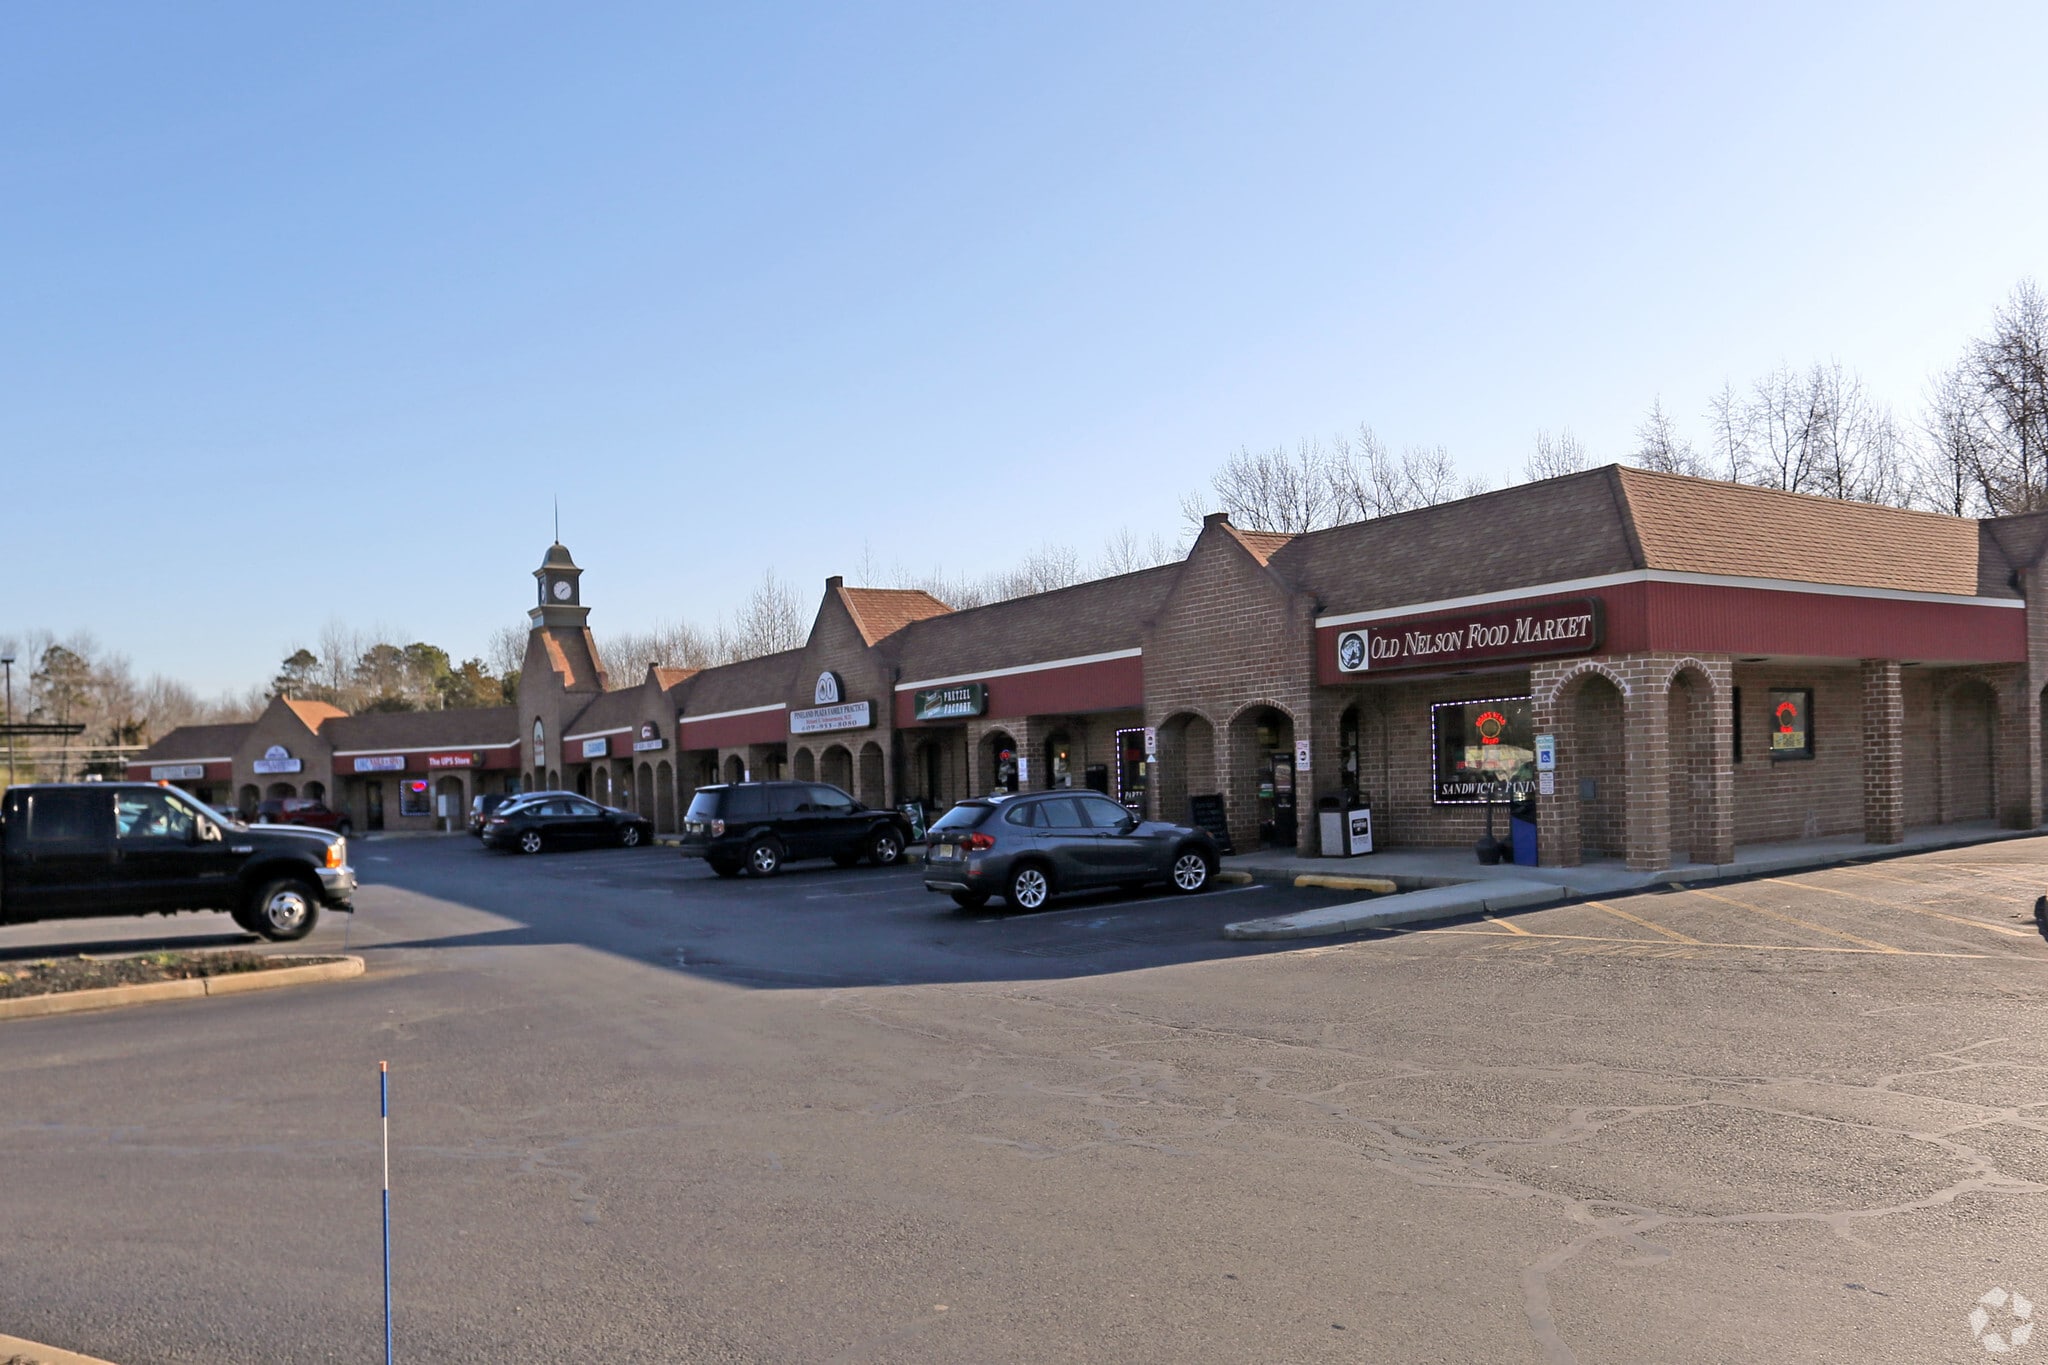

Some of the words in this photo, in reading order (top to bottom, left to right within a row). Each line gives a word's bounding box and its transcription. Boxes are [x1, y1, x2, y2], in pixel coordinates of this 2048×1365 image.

[1371, 636, 1400, 659] OLD
[1402, 630, 1464, 656] NELSON
[1466, 623, 1510, 649] FOOD
[1512, 614, 1592, 644] MARKET
[943, 689, 970, 701] PRETZEL
[943, 702, 971, 714] FACTORY
[429, 757, 440, 765] The
[441, 756, 453, 766] UPS
[454, 756, 470, 765] Store
[1442, 782, 1494, 795] SANDWICH
